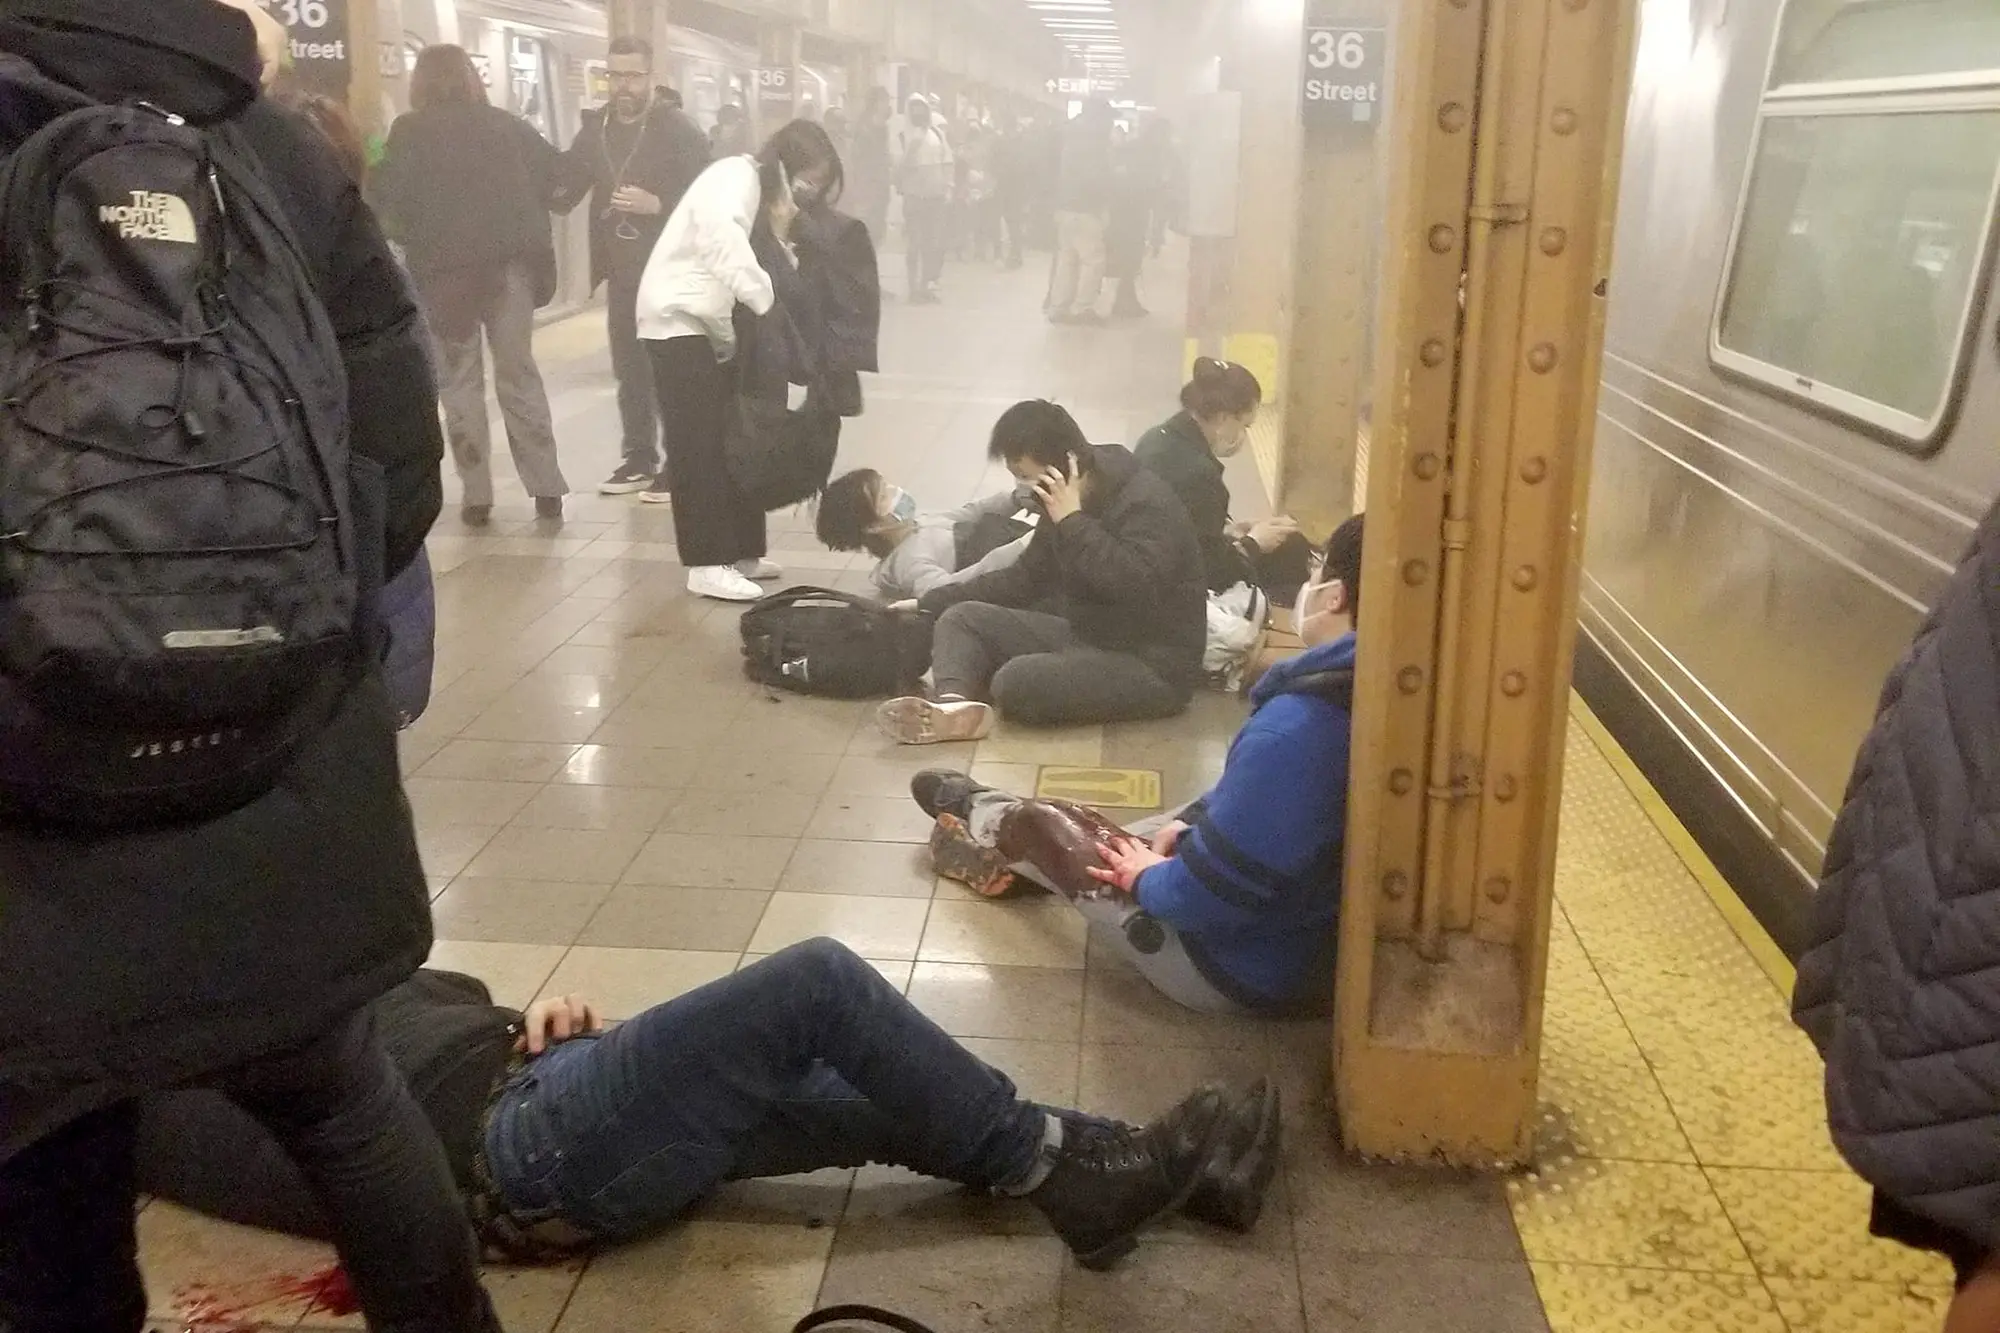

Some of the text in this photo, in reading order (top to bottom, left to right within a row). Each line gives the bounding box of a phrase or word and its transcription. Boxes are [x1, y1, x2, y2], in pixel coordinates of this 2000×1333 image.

[290, 38, 345, 60] treet
[1308, 31, 1365, 69] 36
[759, 70, 786, 86] 36
[1305, 79, 1377, 102] Street
[129, 190, 168, 208] THE
[99, 205, 168, 225] NORTH
[120, 222, 169, 240] FACE
